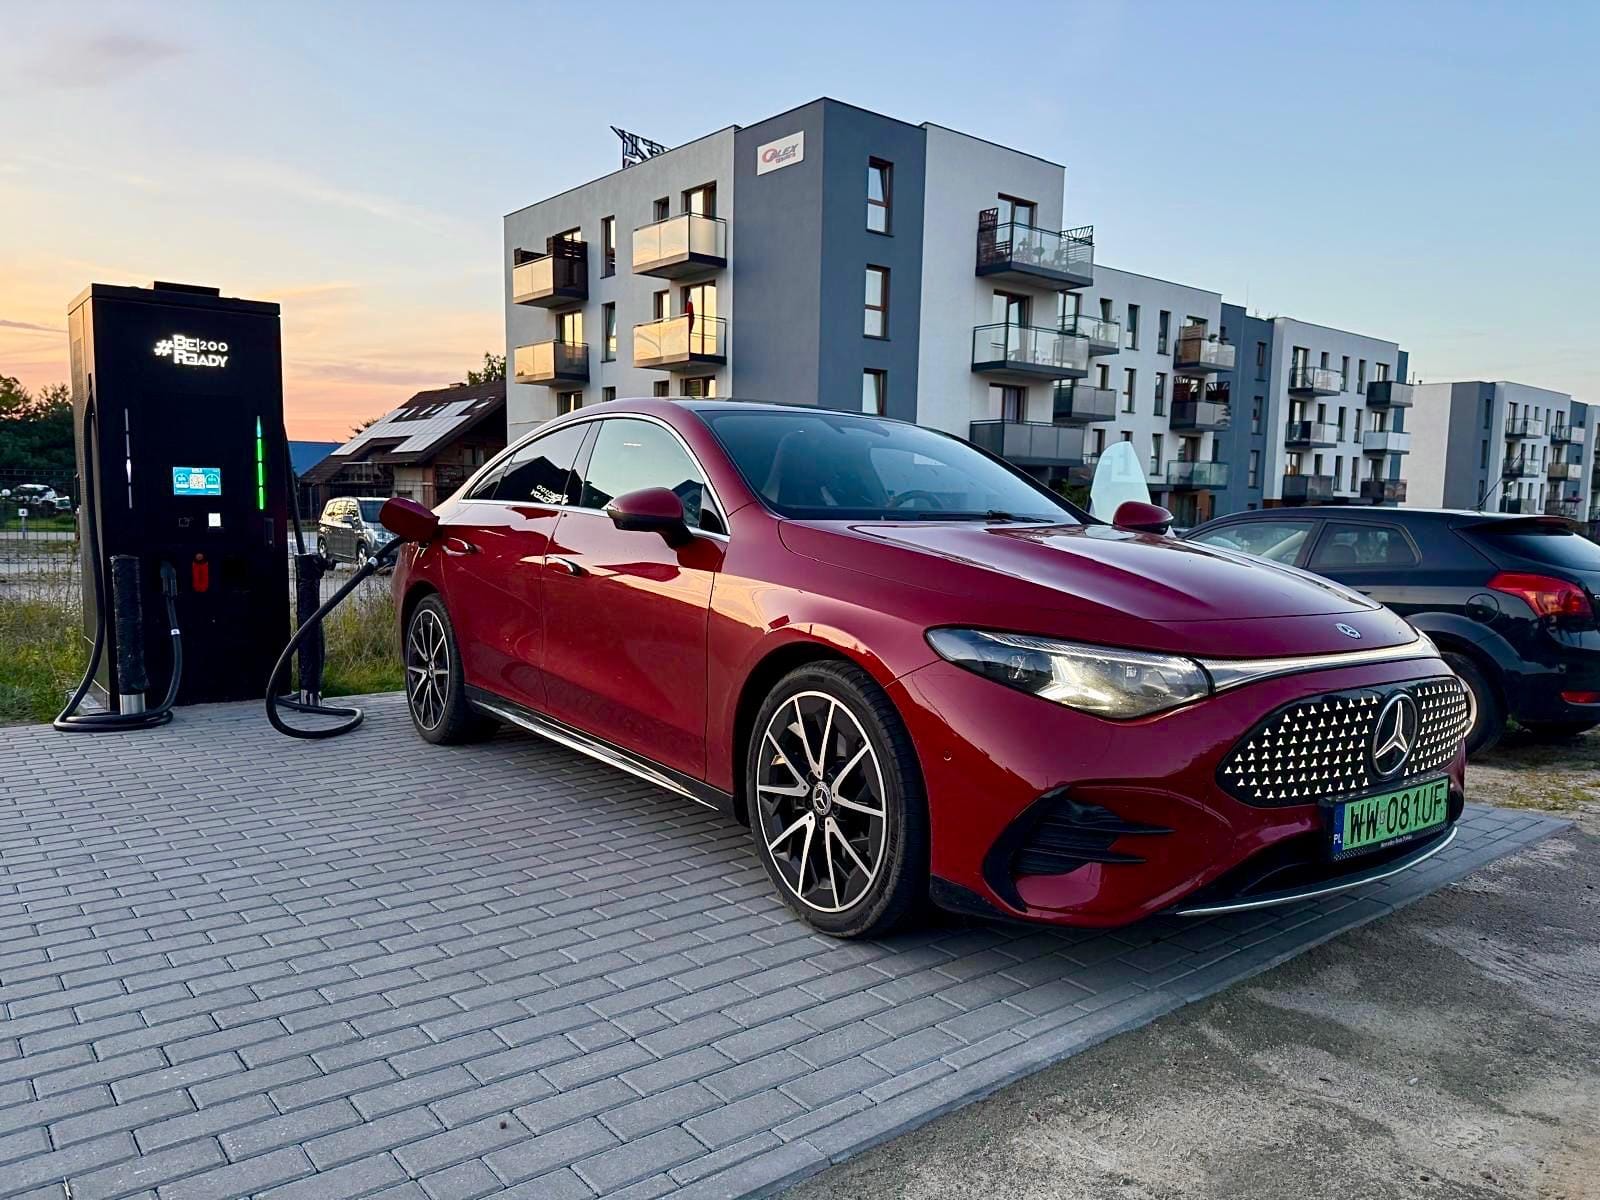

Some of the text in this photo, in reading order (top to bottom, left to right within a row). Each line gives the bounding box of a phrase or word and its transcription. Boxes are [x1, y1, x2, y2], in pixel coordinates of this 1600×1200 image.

[173, 349, 228, 368] READY
[1349, 783, 1445, 845] WW 081UF
[1333, 832, 1342, 845] PL
